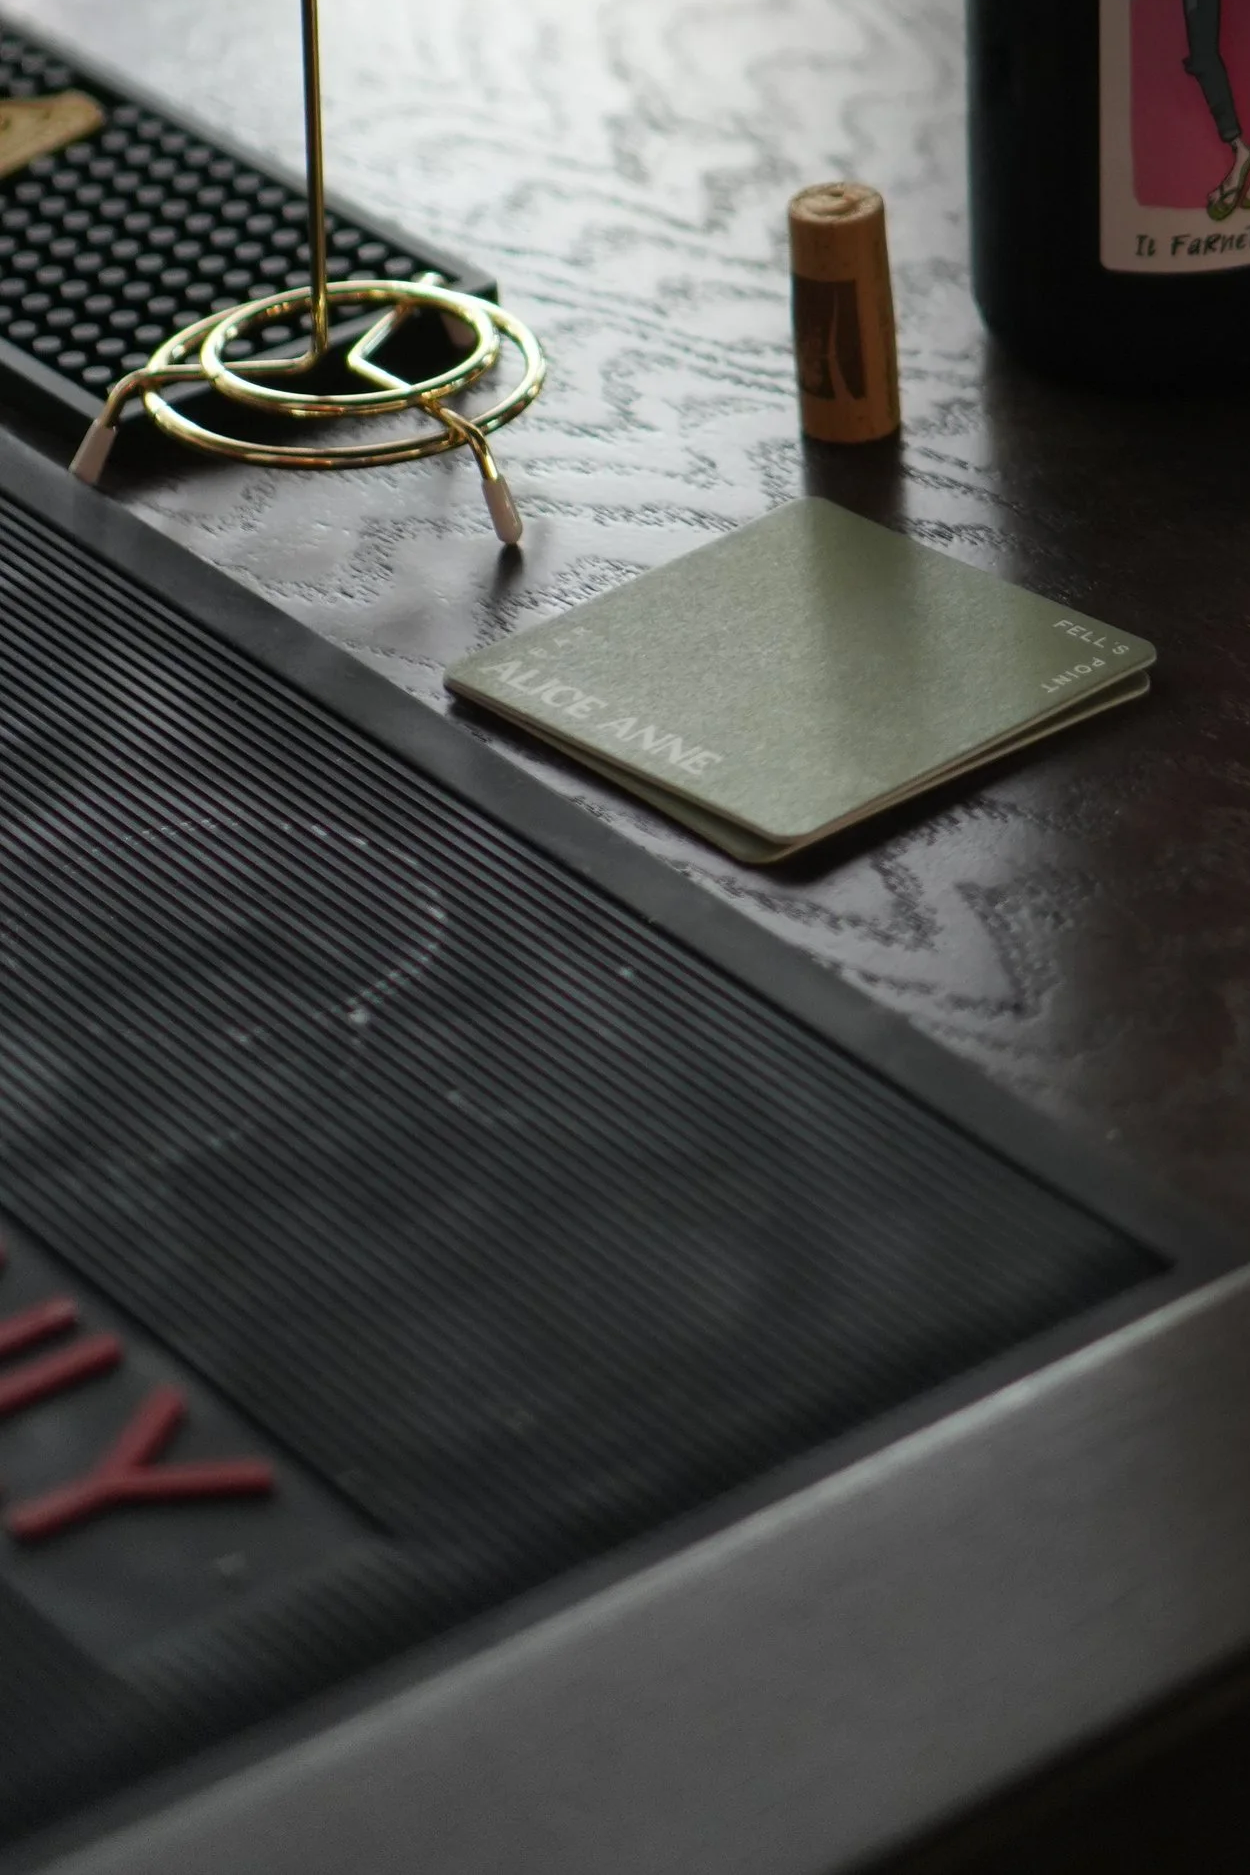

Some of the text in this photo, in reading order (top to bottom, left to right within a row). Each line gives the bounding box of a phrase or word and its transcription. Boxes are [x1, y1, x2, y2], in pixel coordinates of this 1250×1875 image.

[1040, 656, 1105, 693] POINT
[480, 660, 723, 775] ALICE ANNE
